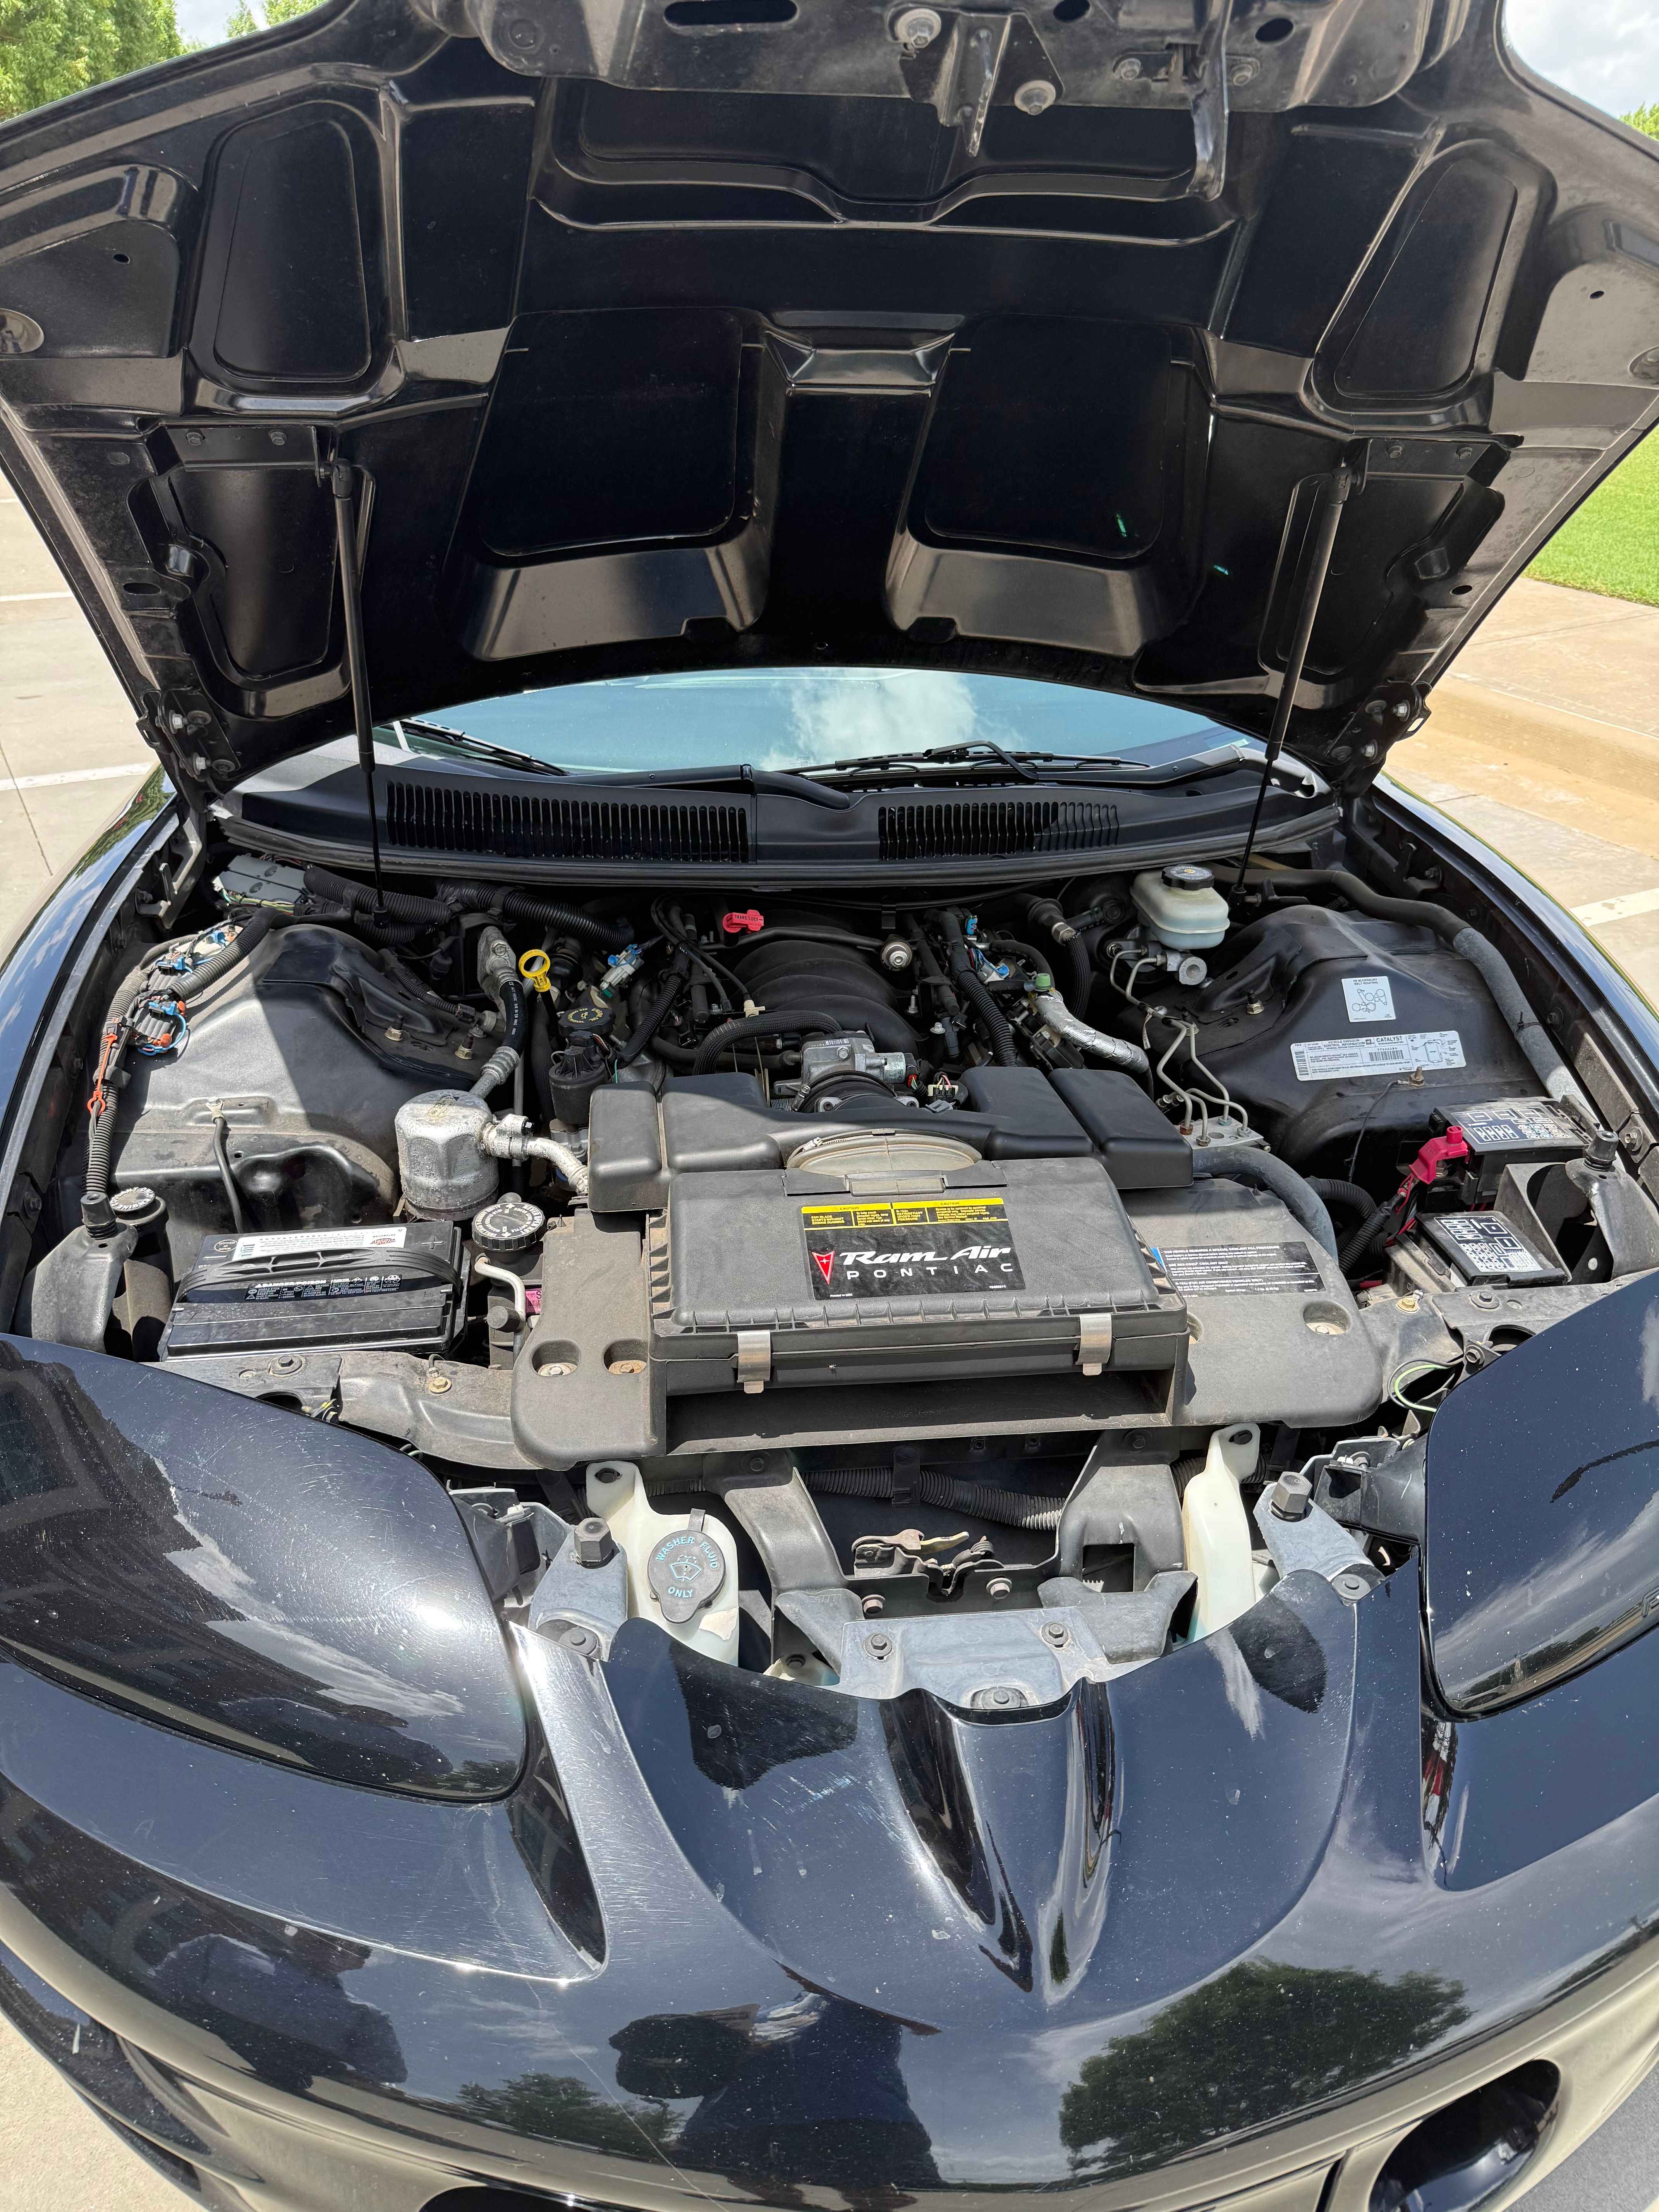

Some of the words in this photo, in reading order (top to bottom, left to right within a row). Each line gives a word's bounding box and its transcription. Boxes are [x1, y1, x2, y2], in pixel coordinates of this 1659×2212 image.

[840, 1250, 948, 1266] Ram
[950, 1245, 1011, 1261] Air
[847, 1263, 1014, 1280] PONTIAC
[656, 1536, 695, 1561] WASHER
[700, 1542, 719, 1569] FLUID
[668, 1587, 693, 1598] ONLY
